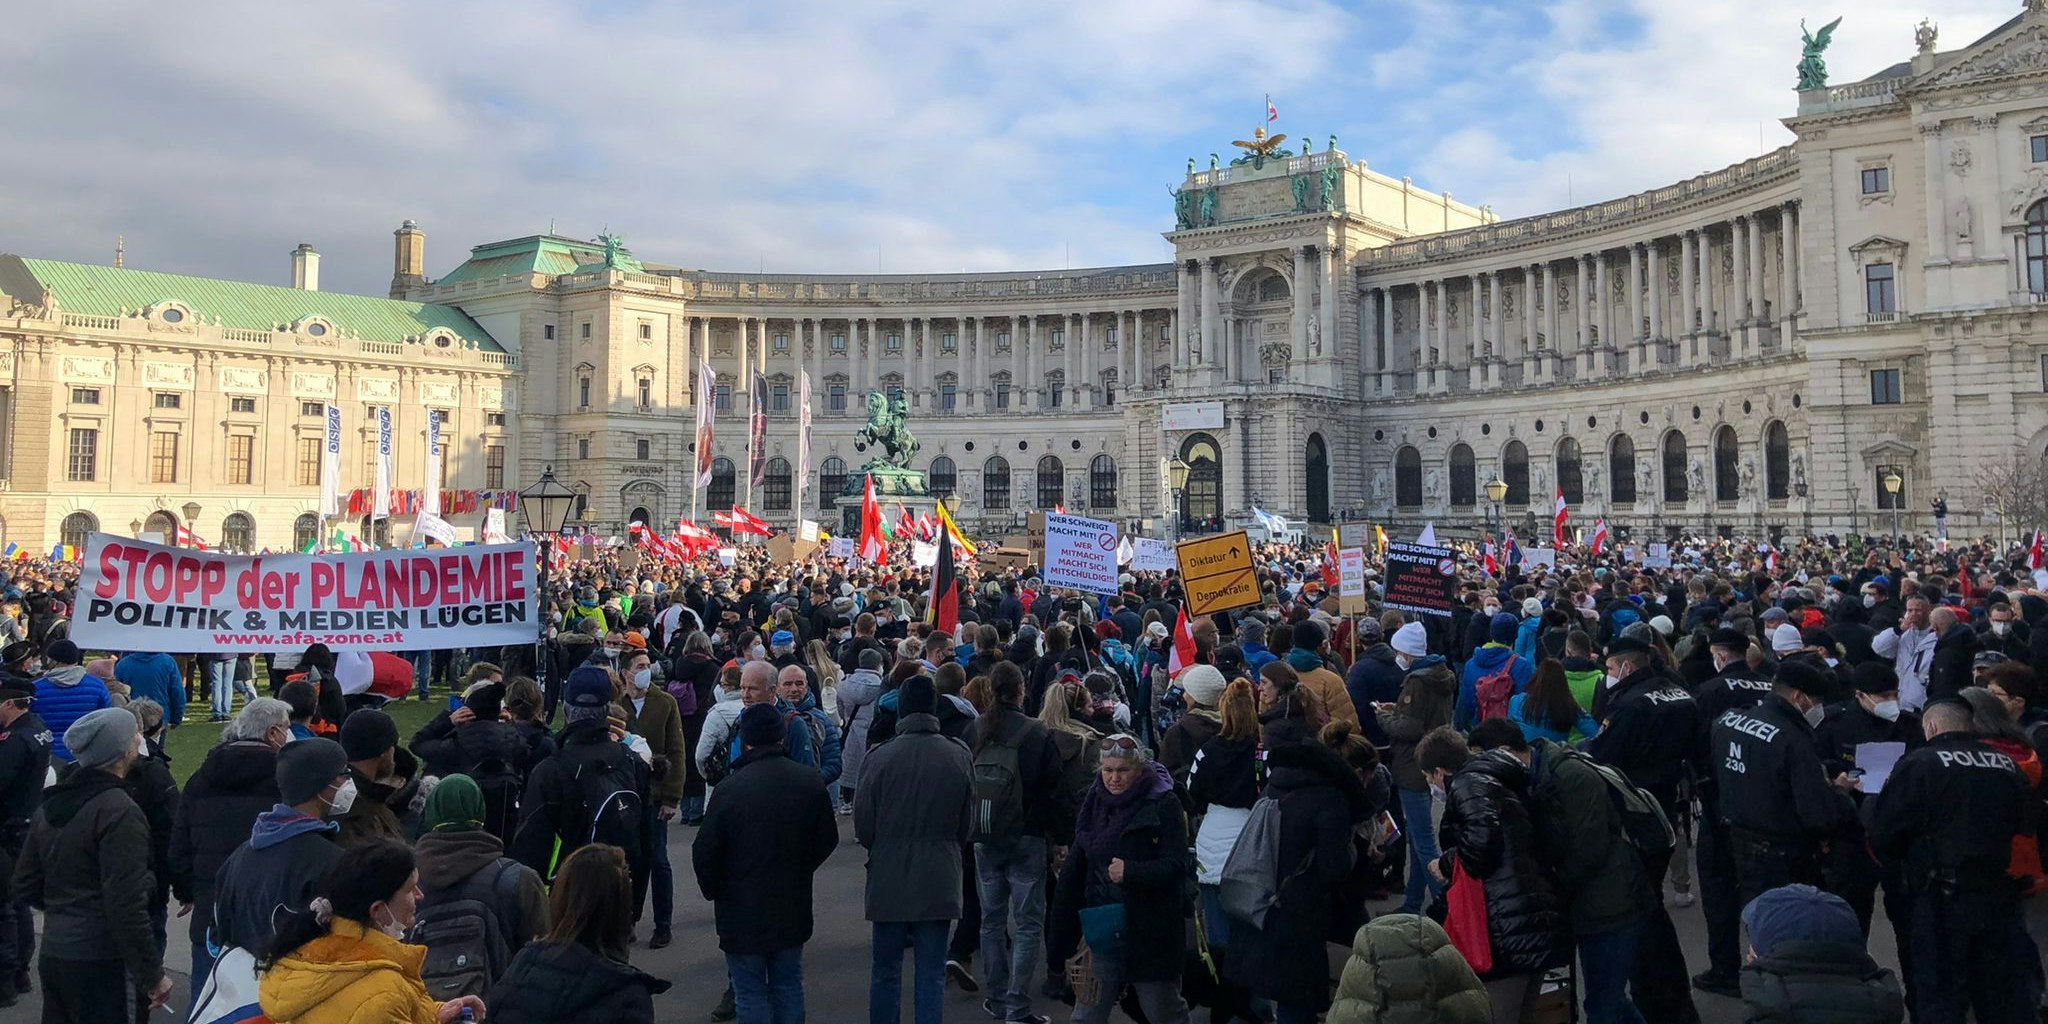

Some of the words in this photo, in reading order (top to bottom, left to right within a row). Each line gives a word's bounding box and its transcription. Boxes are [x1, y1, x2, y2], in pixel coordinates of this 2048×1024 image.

[1049, 515, 1067, 525] WER
[1068, 518, 1109, 531] SCHWEIGT
[1048, 526, 1078, 536] MACHT
[1080, 531, 1097, 540] MIT!
[1074, 541, 1092, 550] WER
[1389, 542, 1408, 552] WER
[1409, 544, 1451, 557] SCHWEIGT
[1061, 549, 1105, 561] MITMACHT
[1190, 552, 1226, 568] Diktatur
[1388, 553, 1418, 563] MACHT
[1418, 557, 1437, 566] MIT!
[1058, 558, 1087, 568] MACHT
[1089, 563, 1107, 572] SICH
[1412, 566, 1431, 574] WER
[95, 543, 226, 606] STOPP
[237, 557, 299, 610] der
[311, 551, 525, 609] PLANDEMIE
[1050, 567, 1114, 583] MITSCHULDIG!!!
[1398, 574, 1443, 586] MITMACHT
[1047, 579, 1063, 587] NEIN
[1064, 581, 1078, 589] ZUM
[1080, 583, 1117, 595] IMPFZWANG
[1196, 583, 1250, 602] Demokratie
[1394, 583, 1423, 593] MACHT
[1425, 587, 1444, 597] SICH
[1383, 602, 1398, 610] NEIN
[1399, 603, 1413, 611] ZUM
[88, 599, 232, 630] POLITIK
[243, 611, 266, 631] &
[279, 610, 409, 631] MEDIEN
[420, 602, 526, 629] LÜGEN
[213, 630, 404, 645] www.afa-zone.at
[1719, 711, 1779, 743] POLIZEI
[1730, 741, 1741, 759] N
[1725, 757, 1746, 773] 230
[1936, 751, 2016, 773] POLIZEI
